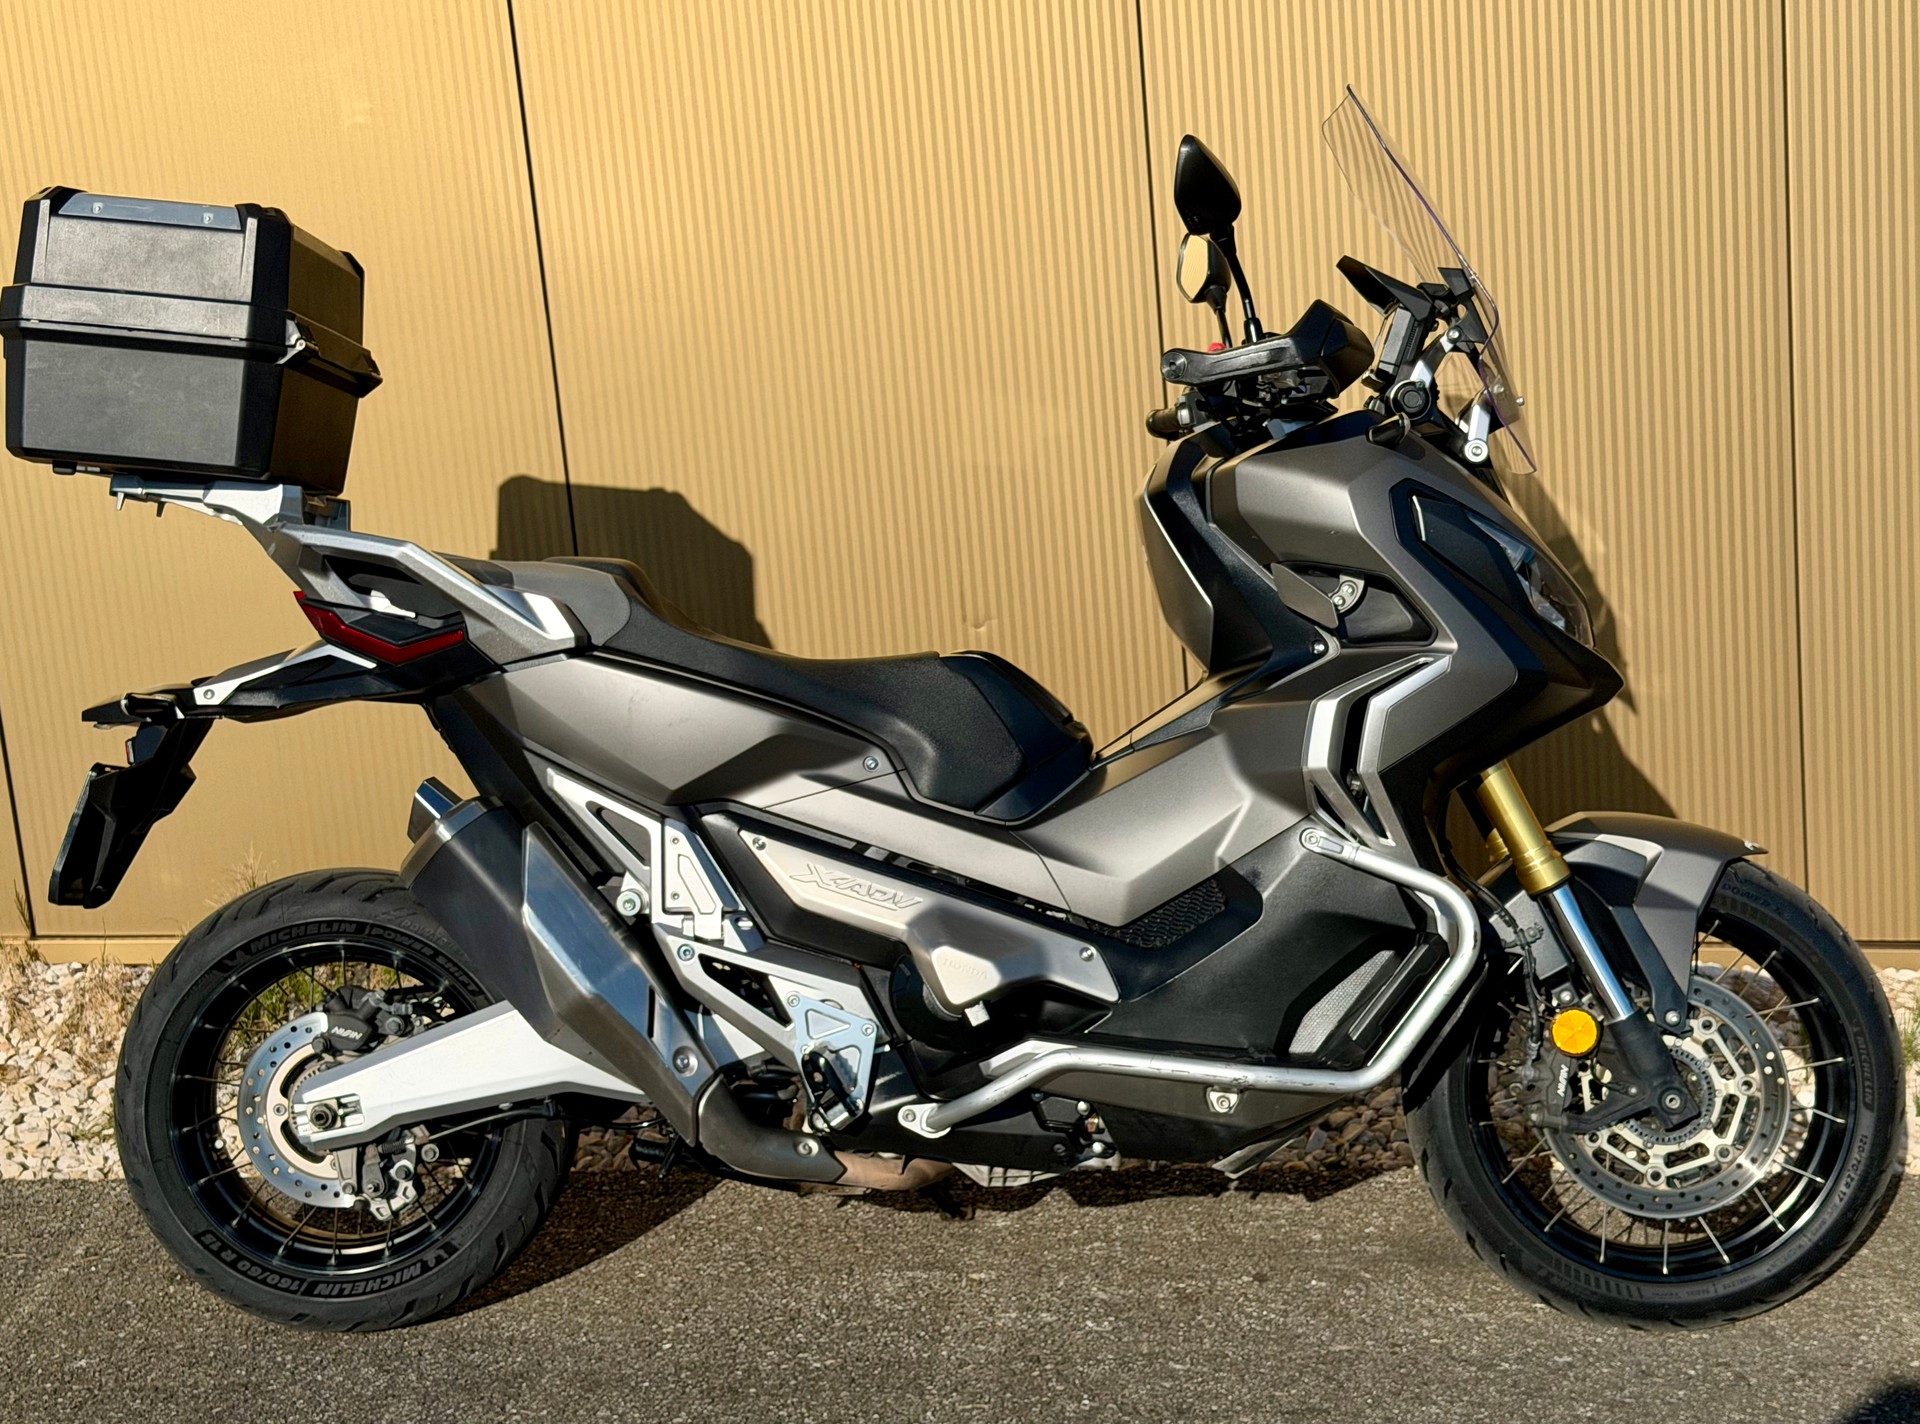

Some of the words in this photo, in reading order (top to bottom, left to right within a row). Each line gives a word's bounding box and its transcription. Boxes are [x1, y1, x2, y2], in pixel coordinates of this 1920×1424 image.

[250, 921, 357, 954] MICHELIN
[370, 927, 434, 957] POWER
[435, 955, 480, 995] SHIFT
[940, 957, 988, 980] HONDA
[1855, 1036, 1873, 1105] MICHELIN
[200, 1233, 222, 1251] 15
[220, 1248, 238, 1262] R
[236, 1260, 301, 1291] 160/60
[313, 1261, 422, 1296] MICHELIN
